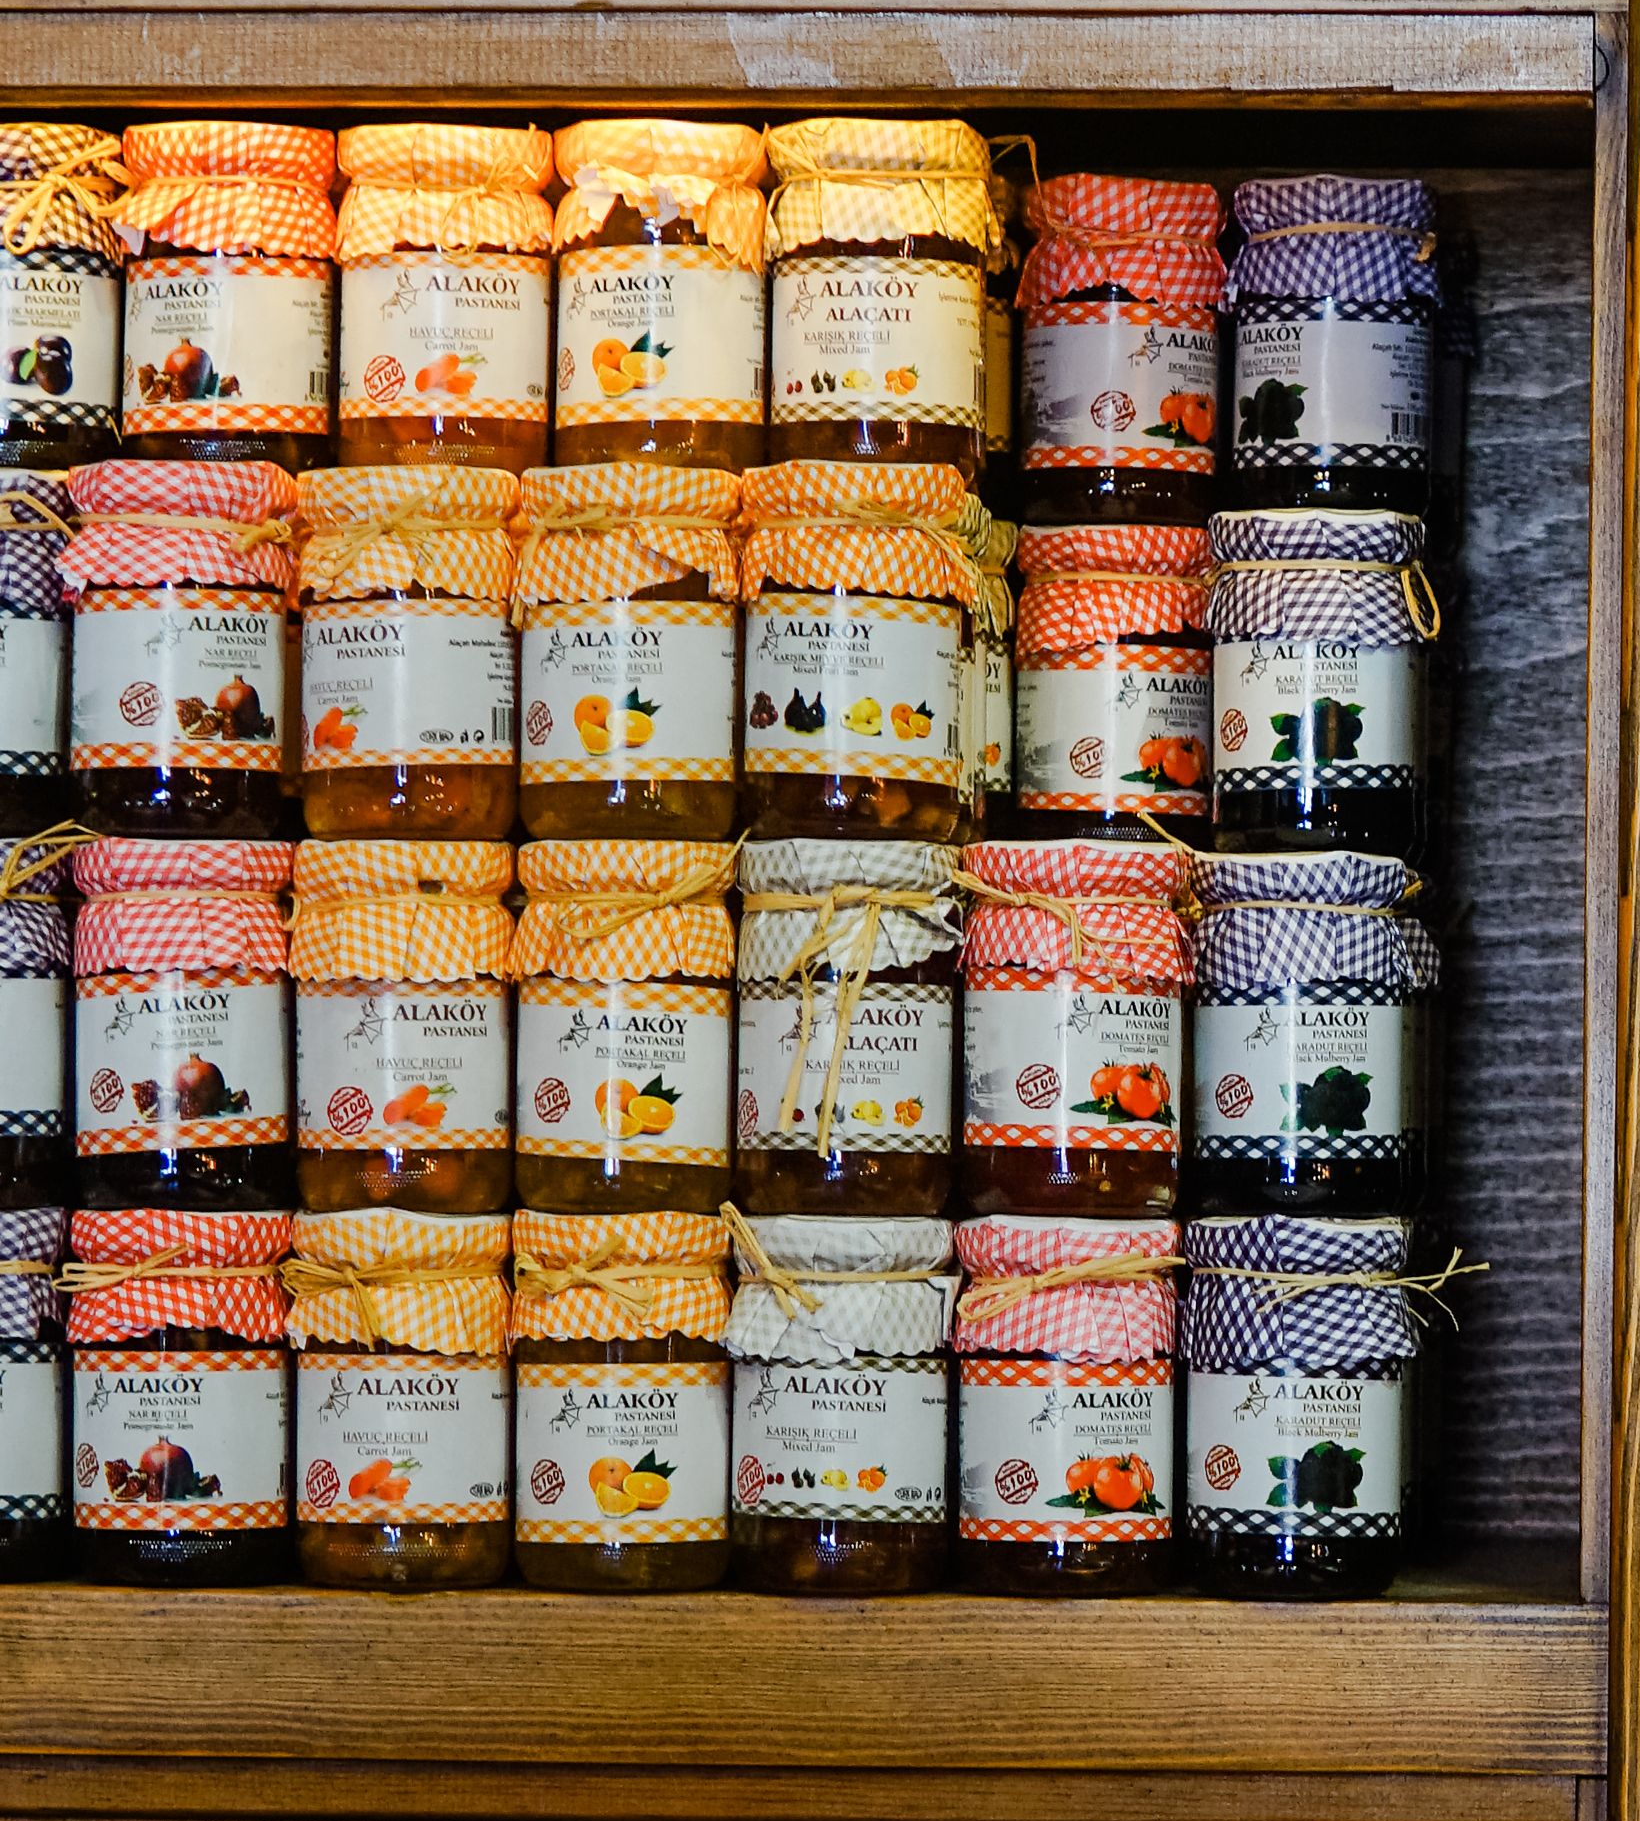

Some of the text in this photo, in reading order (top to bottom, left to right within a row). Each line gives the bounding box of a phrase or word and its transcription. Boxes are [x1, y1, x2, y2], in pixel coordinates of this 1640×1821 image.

[426, 272, 520, 294] ALAKÖY
[589, 272, 674, 294] ALAKÖY
[820, 272, 918, 298] ALAKÖY
[455, 296, 521, 311] PASTANESİ
[826, 307, 912, 325] ALAÇATI
[1240, 325, 1303, 347] ALAKÖY
[460, 341, 480, 352] Jam
[820, 344, 871, 354] Mixed Jam
[189, 613, 268, 634] ALAKÖY
[318, 621, 405, 645] ALAKÖY
[341, 646, 409, 659] PASTANESİ
[393, 999, 487, 1022] ALAKÖY
[1099, 997, 1171, 1019] ALAKÖY
[423, 1024, 487, 1039] PASTANESİ
[393, 1072, 448, 1082] Carrot Jam
[113, 1374, 203, 1393] ALAKÖY
[357, 1371, 459, 1396] ALAKÖY
[784, 1372, 887, 1398] ALAKÖY
[1274, 1381, 1364, 1401] ALAKÖY
[139, 1395, 201, 1409] PASTANESİ
[386, 1398, 460, 1411] PASTANESİ
[586, 1387, 679, 1409] ALAKÖY
[813, 1398, 886, 1413] PASTANESİ
[1074, 1385, 1153, 1409] ALAKÖY
[615, 1410, 676, 1421] PASTANESİ
[1101, 1408, 1151, 1421] PASTANESİ
[1304, 1402, 1361, 1414] PASTANESİ
[343, 1430, 428, 1446] HAVUÇ REÇELİ
[608, 1436, 658, 1448] Orange Jam
[766, 1424, 808, 1443] KARIŞIK
[357, 1447, 412, 1458] Carrot Jam
[783, 1441, 835, 1453] Mixed Jam
